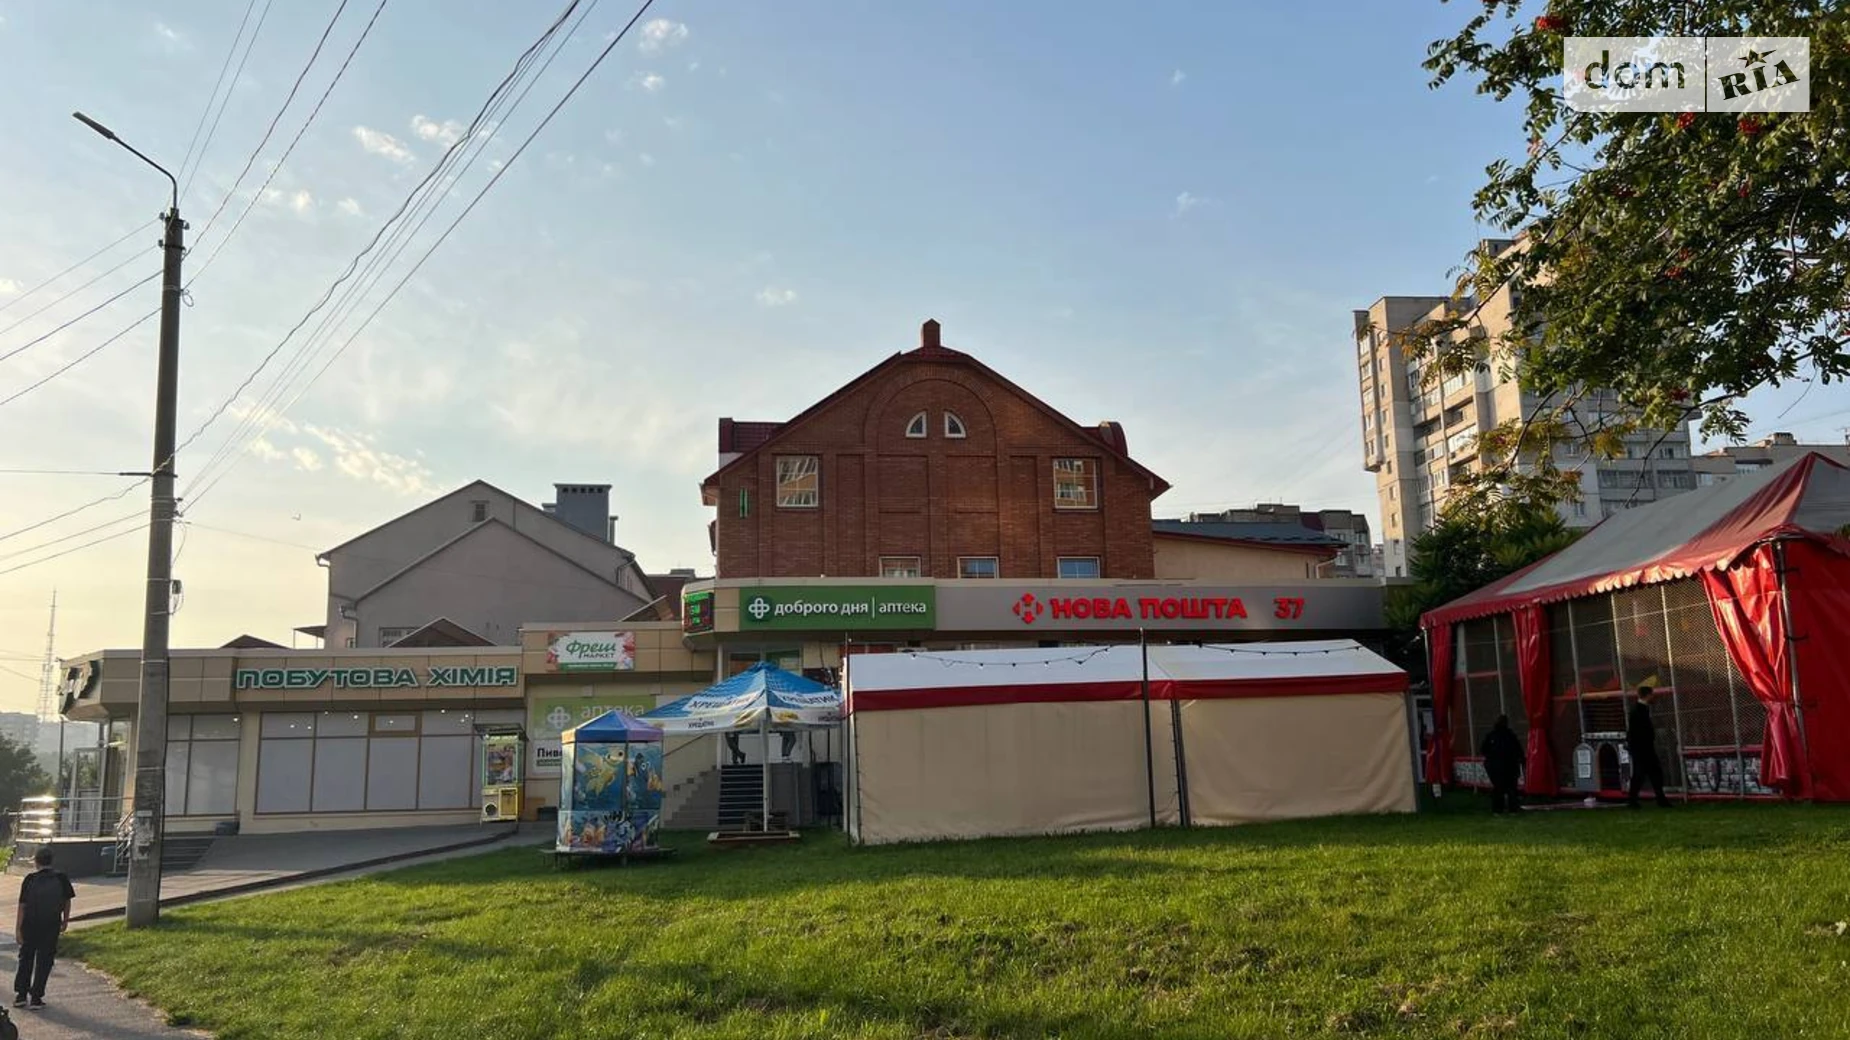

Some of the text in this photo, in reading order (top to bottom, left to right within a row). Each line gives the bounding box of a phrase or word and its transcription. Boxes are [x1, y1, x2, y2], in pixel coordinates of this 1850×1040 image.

[774, 600, 927, 616] доброго дня аптека
[1050, 597, 1247, 619] НОВА ПОШТА
[1273, 598, 1305, 619] 37
[566, 640, 617, 658] Фреш
[236, 667, 517, 689] ПОБУТОВА ХІМІЯ
